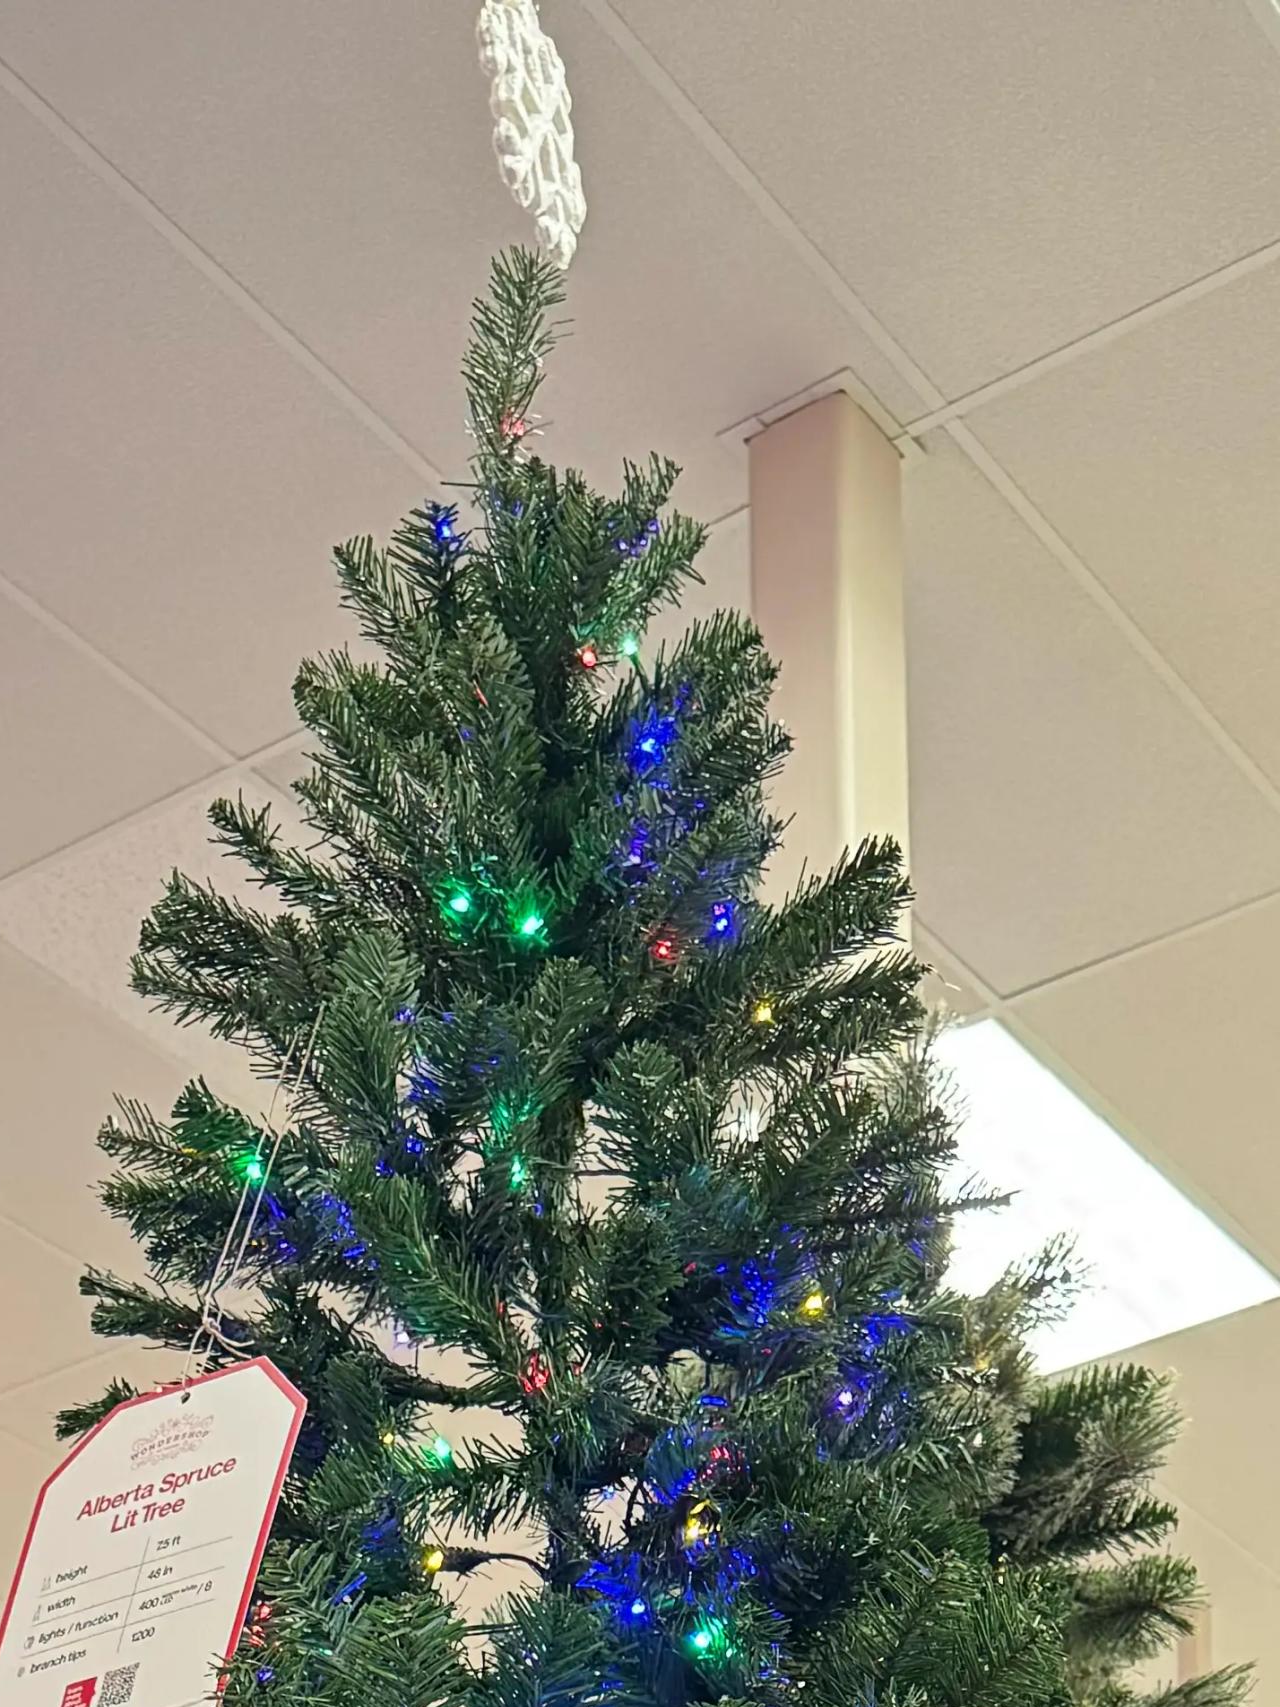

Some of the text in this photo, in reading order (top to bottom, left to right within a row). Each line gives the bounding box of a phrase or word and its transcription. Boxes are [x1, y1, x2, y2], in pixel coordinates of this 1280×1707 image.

[77, 1457, 237, 1520] Alberta Spruce
[110, 1498, 185, 1533] Lit Tree
[55, 1565, 88, 1583] height
[47, 1596, 76, 1612] width
[38, 1611, 119, 1645] lights / function
[30, 1649, 86, 1674] branch tips
